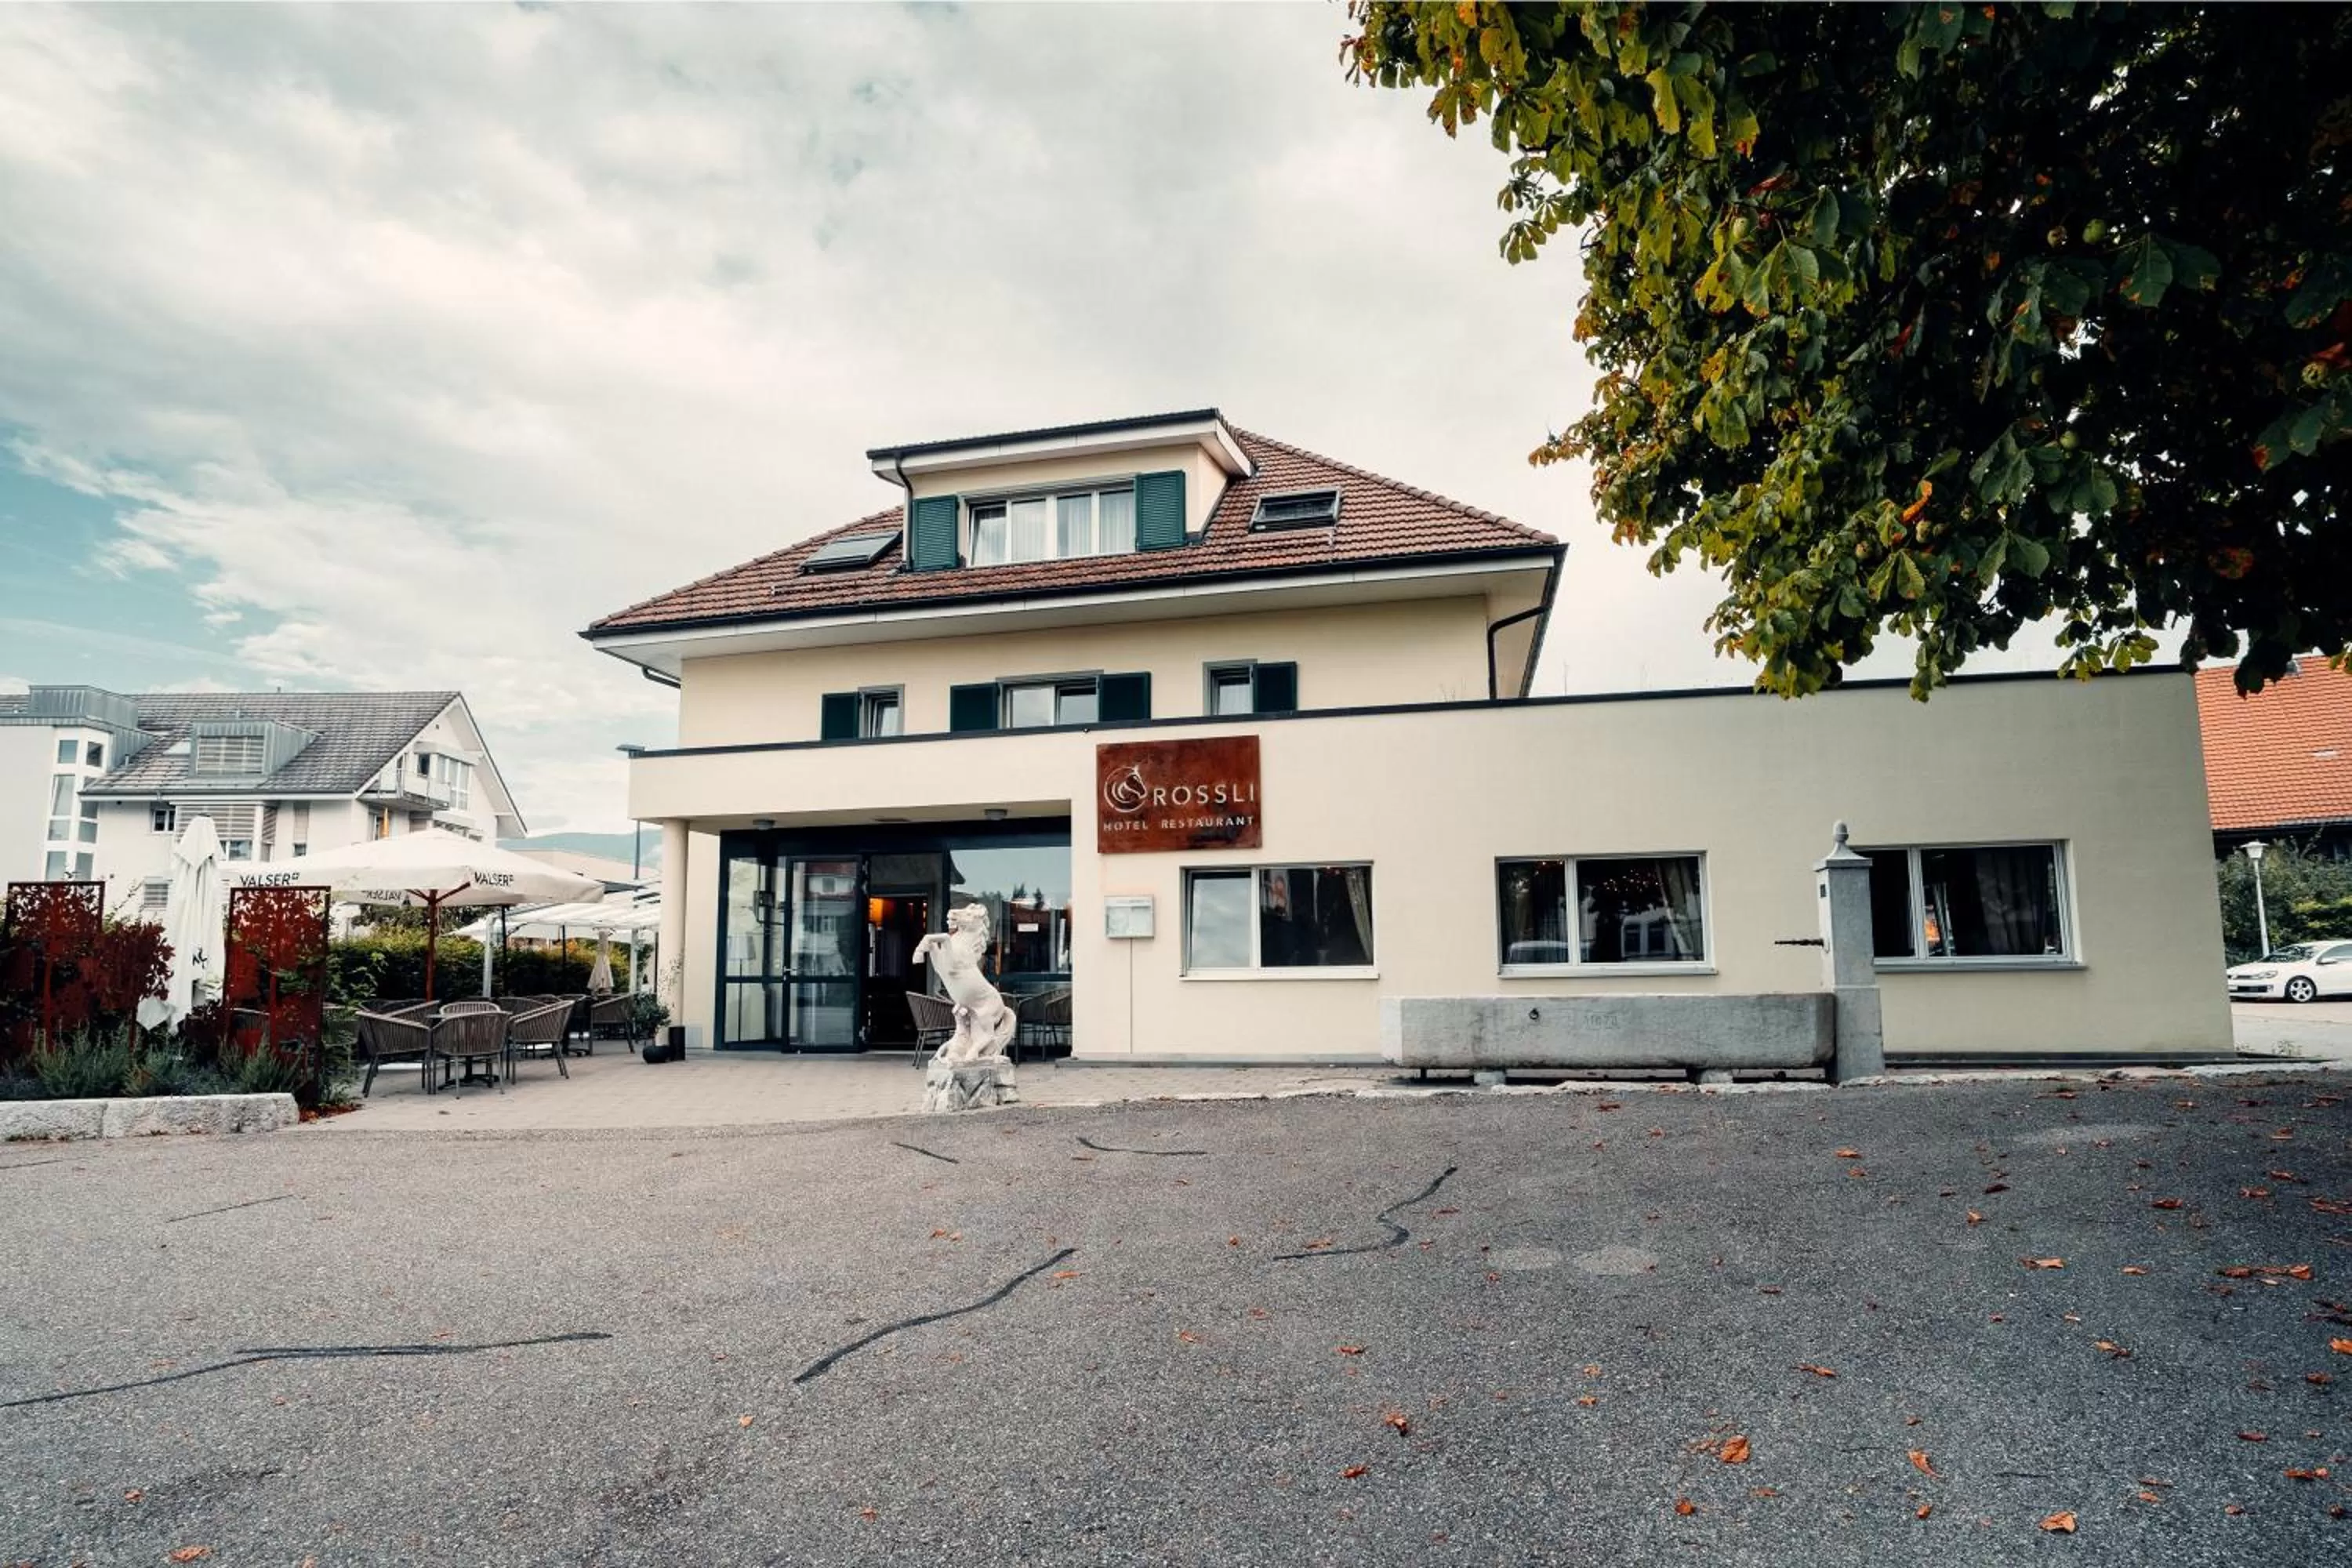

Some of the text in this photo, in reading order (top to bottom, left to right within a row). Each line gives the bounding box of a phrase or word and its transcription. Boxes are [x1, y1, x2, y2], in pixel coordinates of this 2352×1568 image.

[1103, 815, 1253, 831] HOTEL RESTAURANT
[240, 873, 291, 887] VALSER
[474, 871, 509, 886] VALSER
